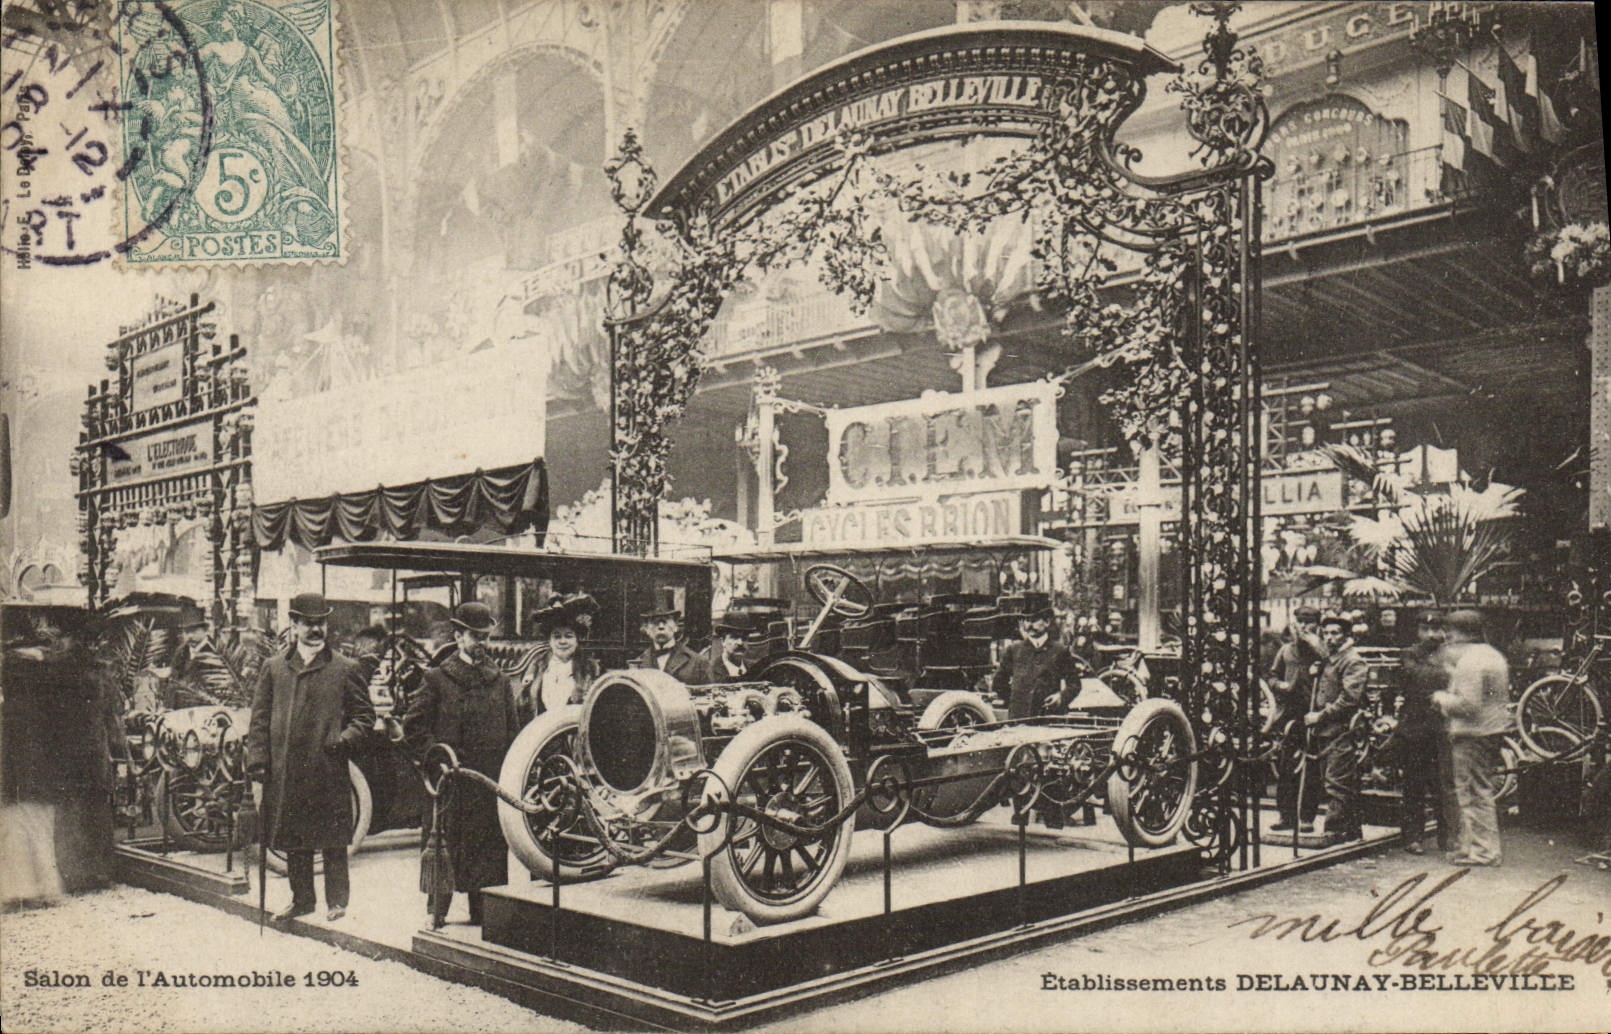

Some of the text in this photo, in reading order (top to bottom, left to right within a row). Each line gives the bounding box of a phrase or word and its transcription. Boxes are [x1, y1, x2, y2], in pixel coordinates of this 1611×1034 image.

[800, 88, 905, 150] DELAUNAY
[907, 76, 1043, 113] BELLEVILLE
[186, 233, 280, 258] POSTES
[810, 508, 912, 542] CYCLES
